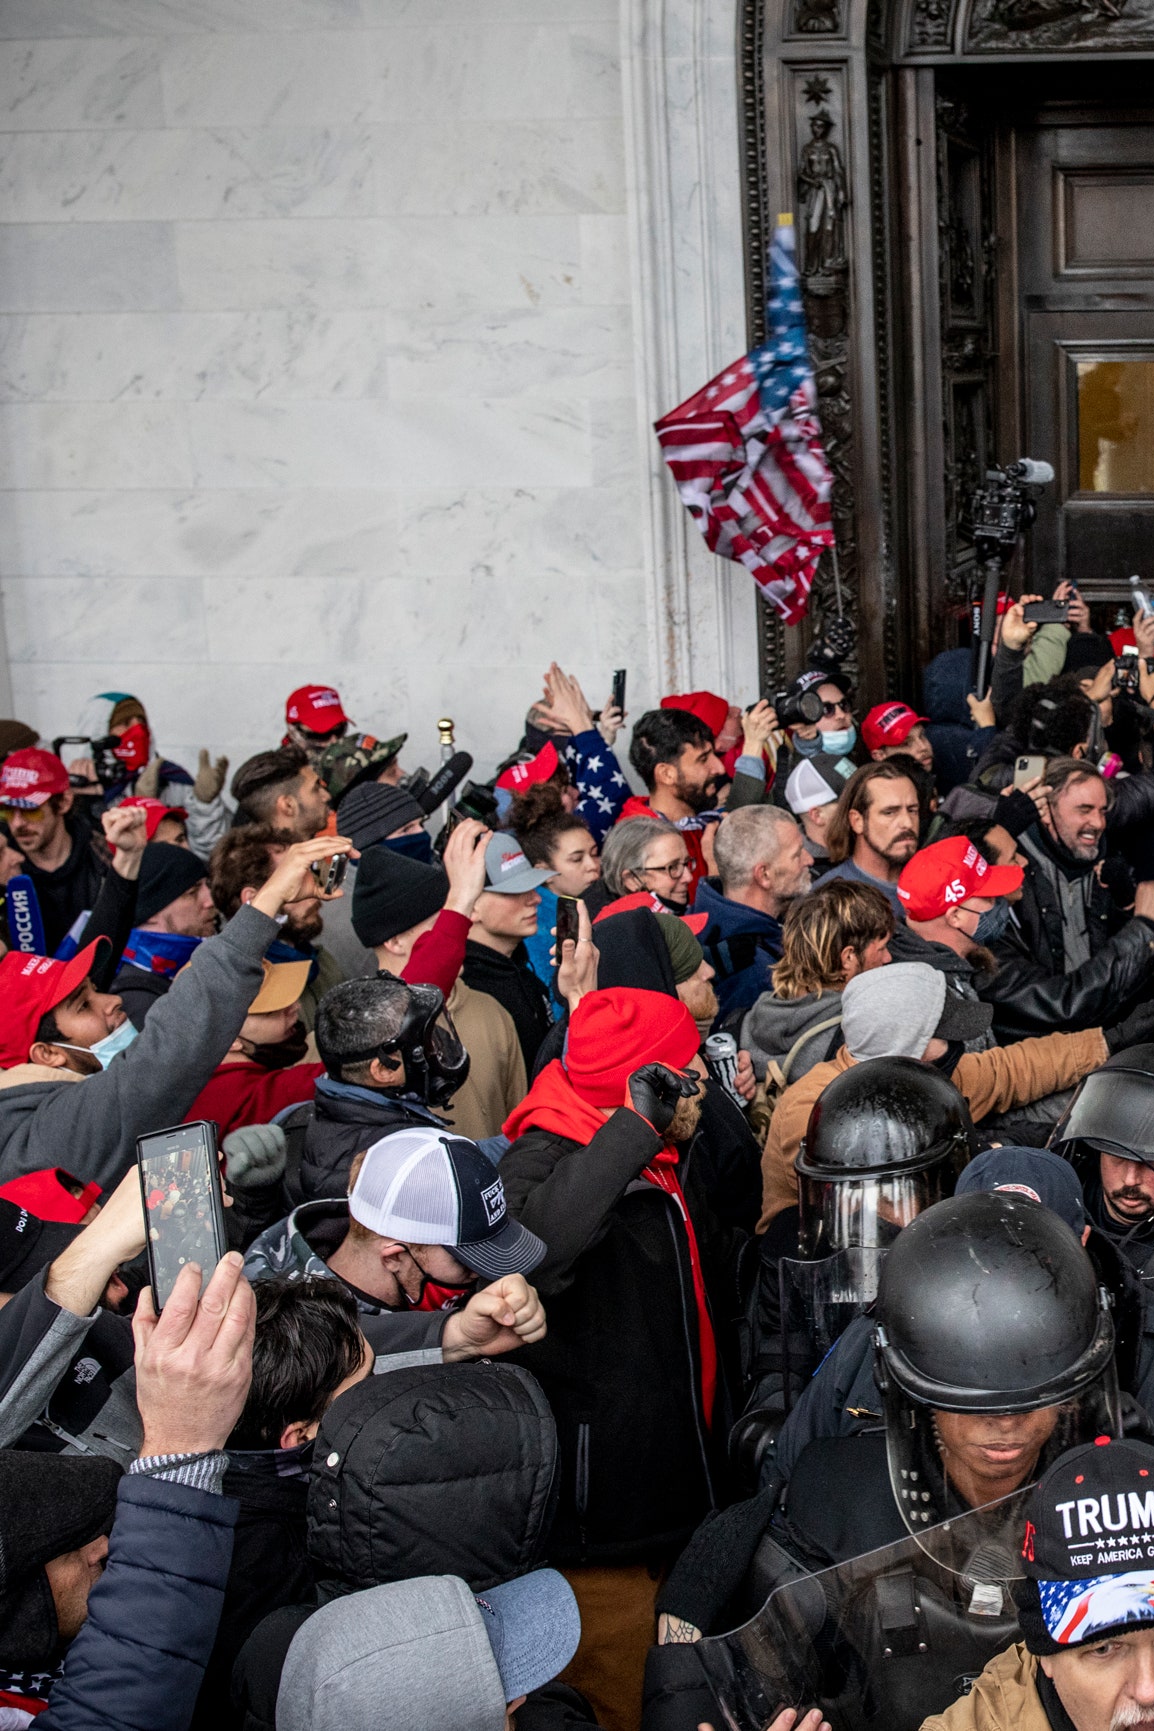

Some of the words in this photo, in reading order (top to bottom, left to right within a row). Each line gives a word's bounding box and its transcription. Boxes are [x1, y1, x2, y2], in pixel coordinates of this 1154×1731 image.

[945, 879, 966, 902] 45
[12, 890, 35, 953] РОССИЯ
[1070, 1553, 1094, 1567] KEEP
[1097, 1549, 1143, 1565] AMERICA
